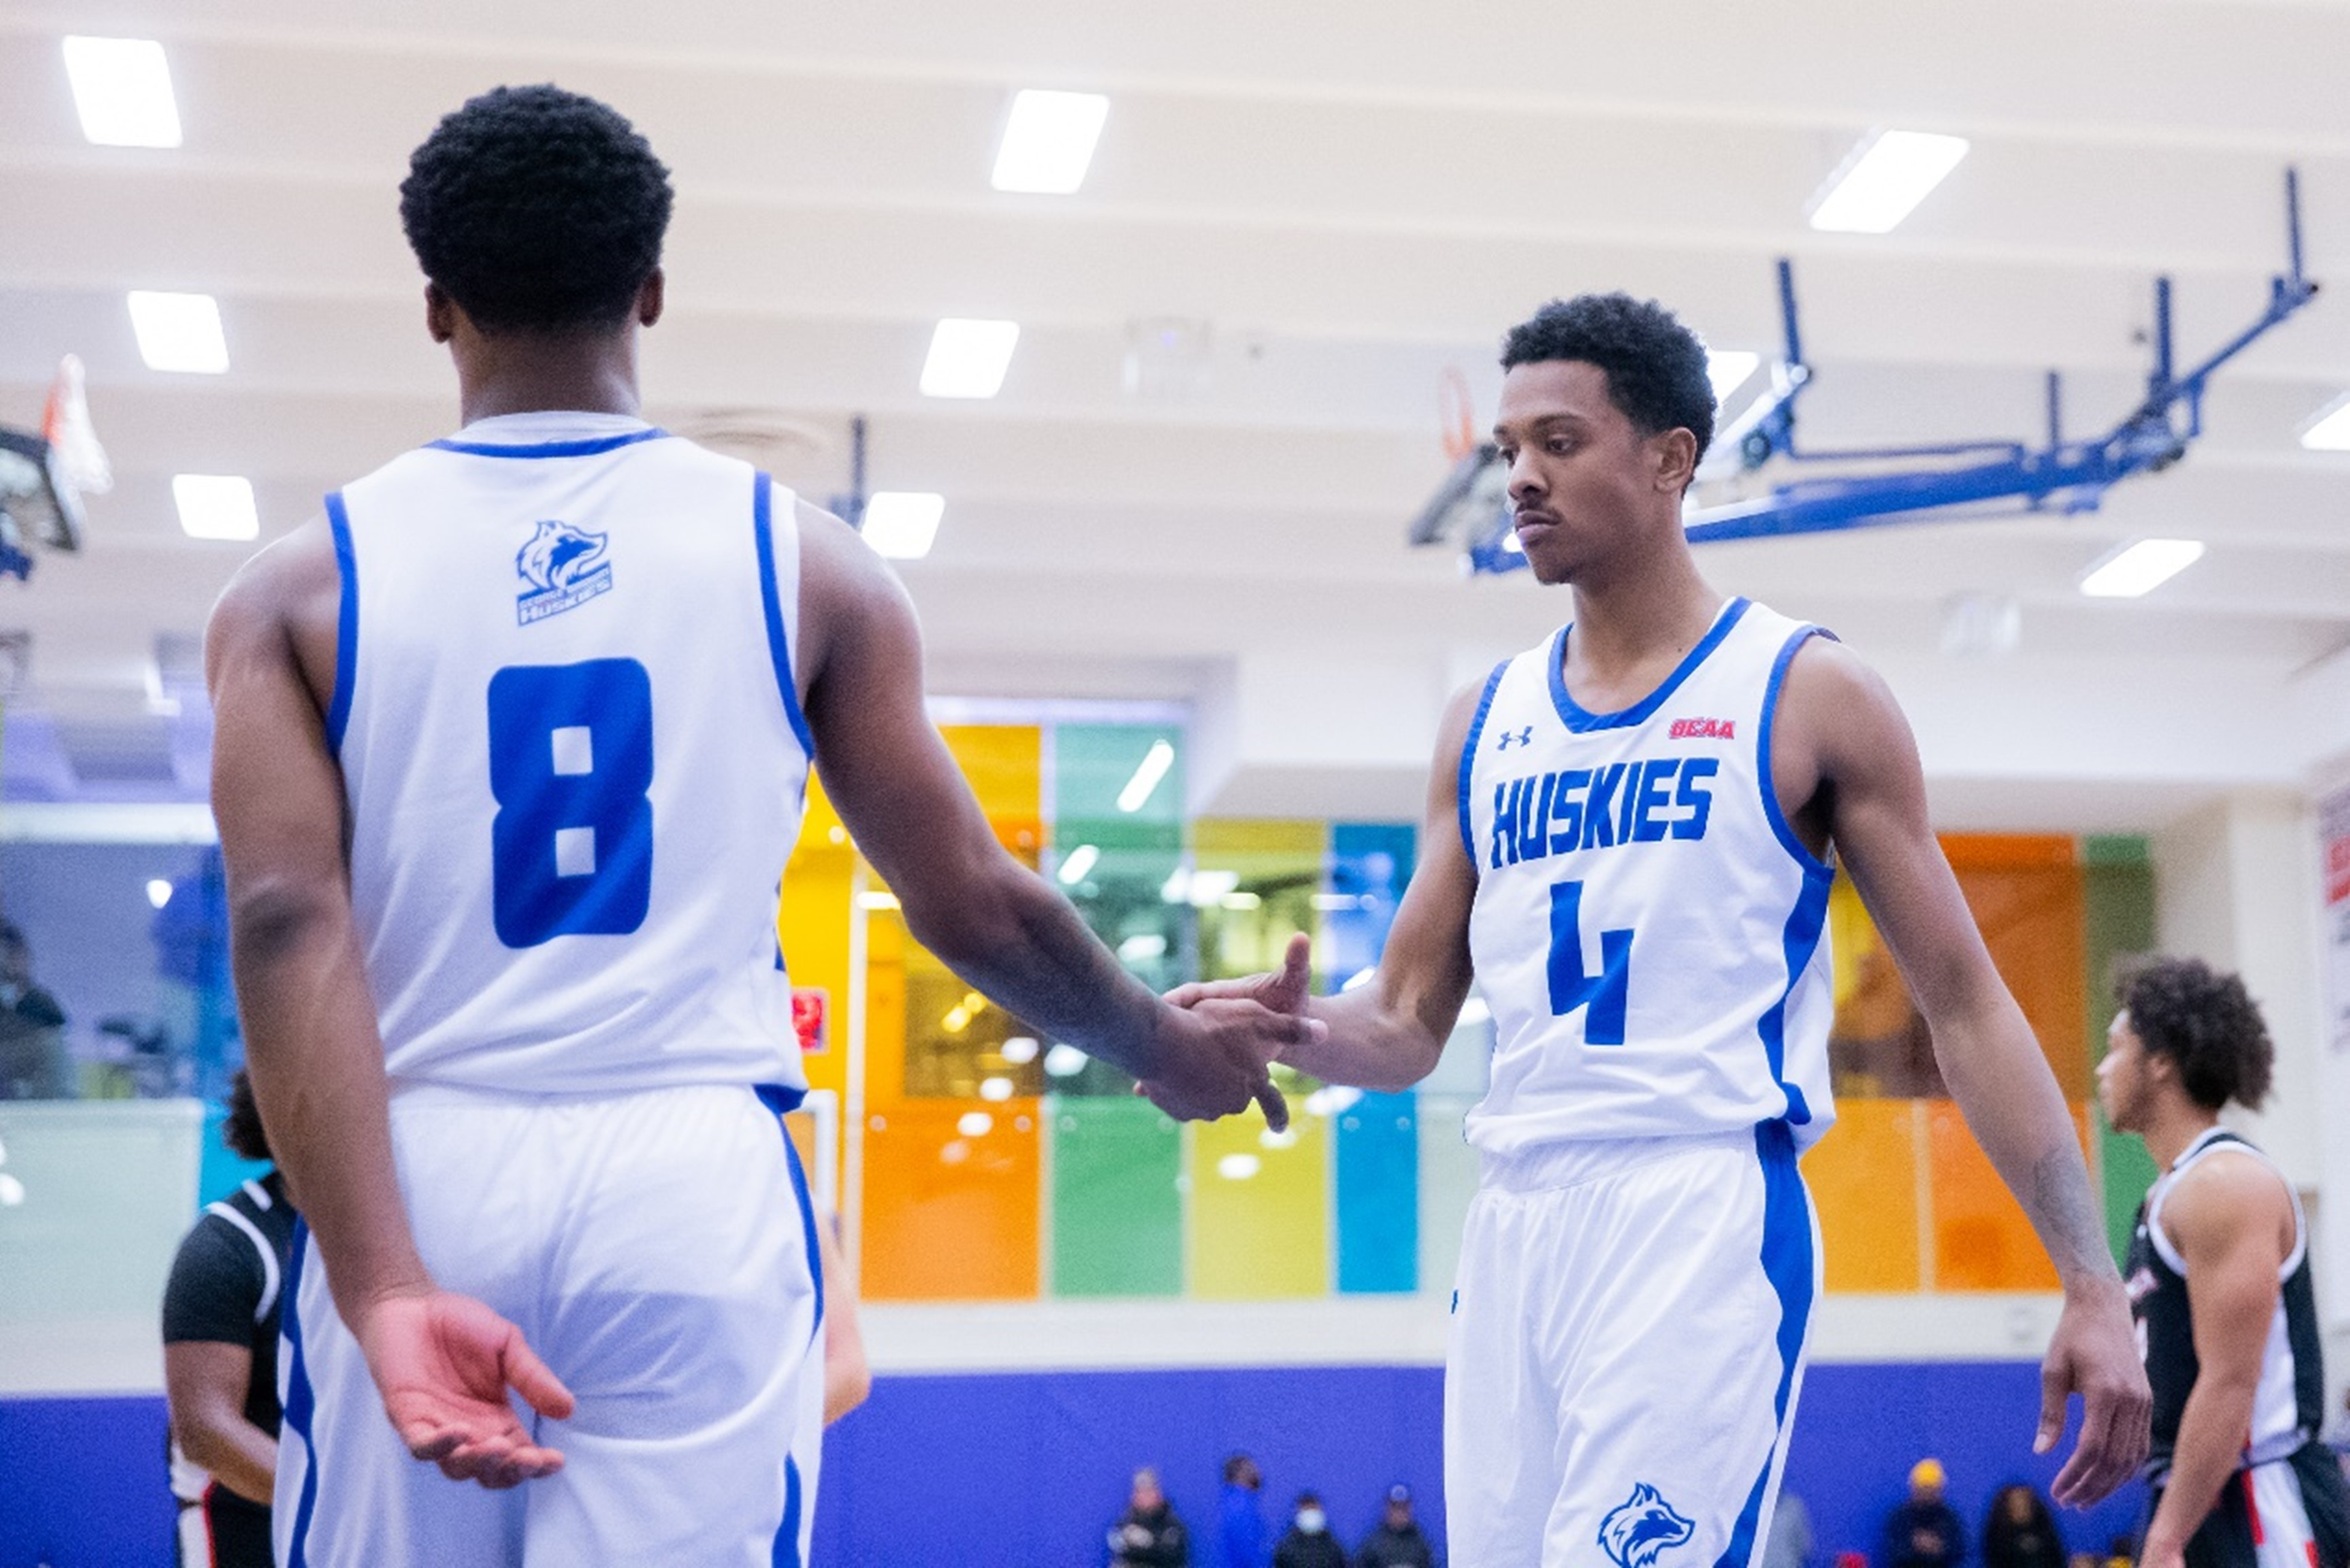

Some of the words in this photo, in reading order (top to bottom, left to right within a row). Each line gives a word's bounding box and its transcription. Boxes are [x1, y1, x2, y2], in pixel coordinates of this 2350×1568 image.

[487, 656, 653, 949] 8
[1491, 757, 1719, 870] HUSKIES
[1546, 880, 1635, 1046] 4
